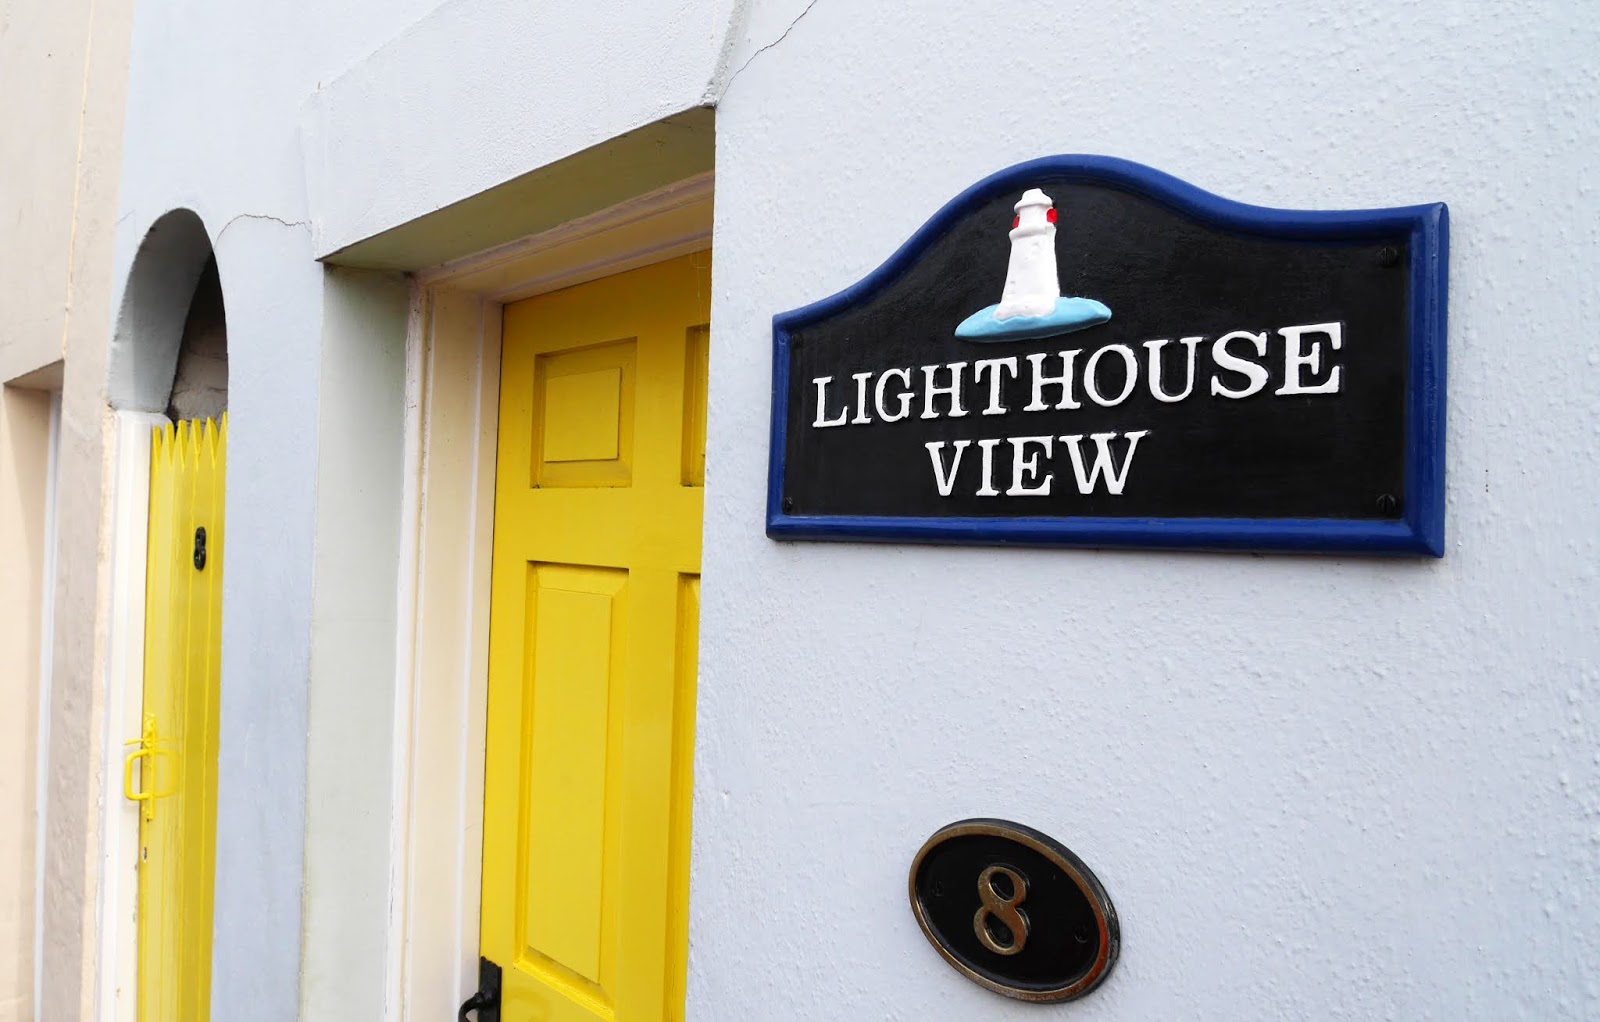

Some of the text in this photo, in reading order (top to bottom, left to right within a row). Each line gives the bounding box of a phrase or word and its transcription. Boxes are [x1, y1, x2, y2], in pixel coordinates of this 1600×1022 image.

[812, 321, 1344, 429] LIGHTHOUSE
[925, 430, 1150, 497] VIEW
[193, 526, 207, 572] 8
[973, 865, 1028, 956] 8
